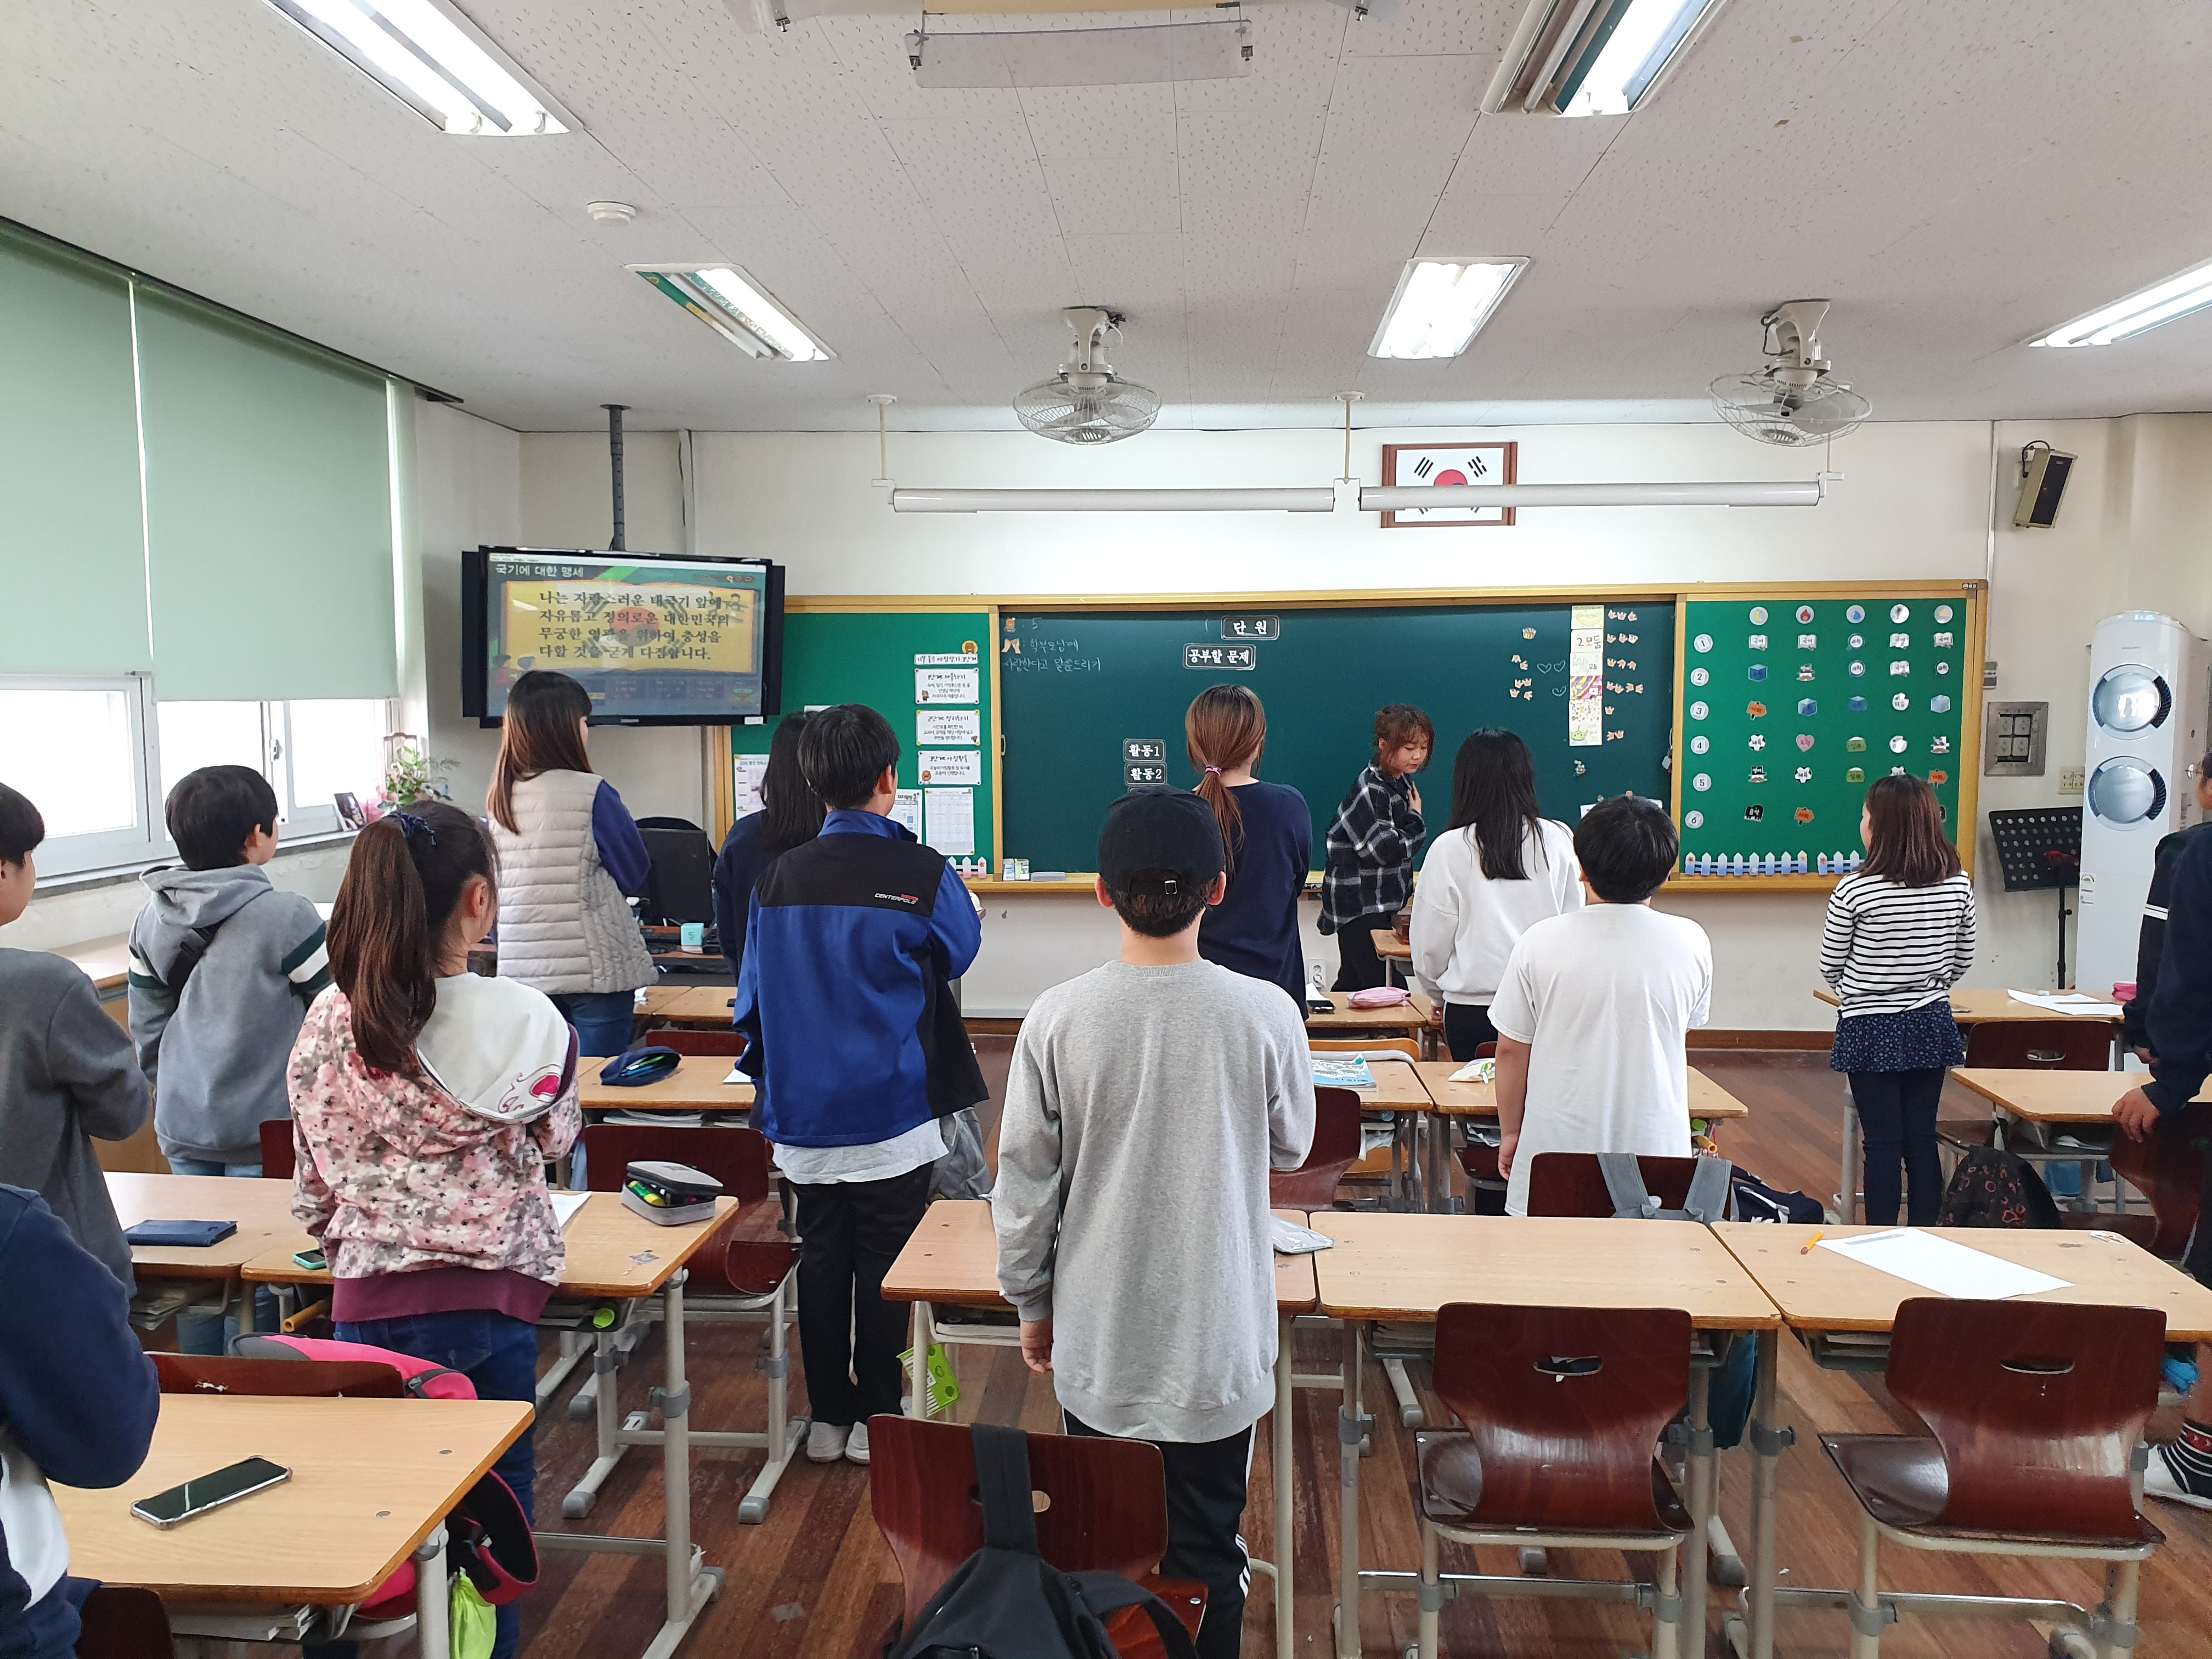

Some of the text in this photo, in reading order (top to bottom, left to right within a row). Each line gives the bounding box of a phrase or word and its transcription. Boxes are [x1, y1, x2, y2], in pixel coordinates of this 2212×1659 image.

[496, 564, 584, 578] 국기에 대한 맹세
[540, 591, 721, 610] 나는 자랑스러운 태극기 앞에
[540, 609, 729, 627] 자유롭고 정의로운 대한민국의
[539, 627, 721, 644] 무궁한 영광을 위하여 충성을
[539, 645, 712, 660] 다할 것을 굳게 다짐합니다.
[1030, 639, 1079, 653] 학부모님께
[1188, 650, 1250, 664] 공부할 문제
[1003, 657, 1101, 672] 사랑한다고 말씀드리기
[1128, 744, 1160, 757] 활동1
[1130, 768, 1162, 780] 활동2
[874, 893, 917, 905] CENTERPOLE
